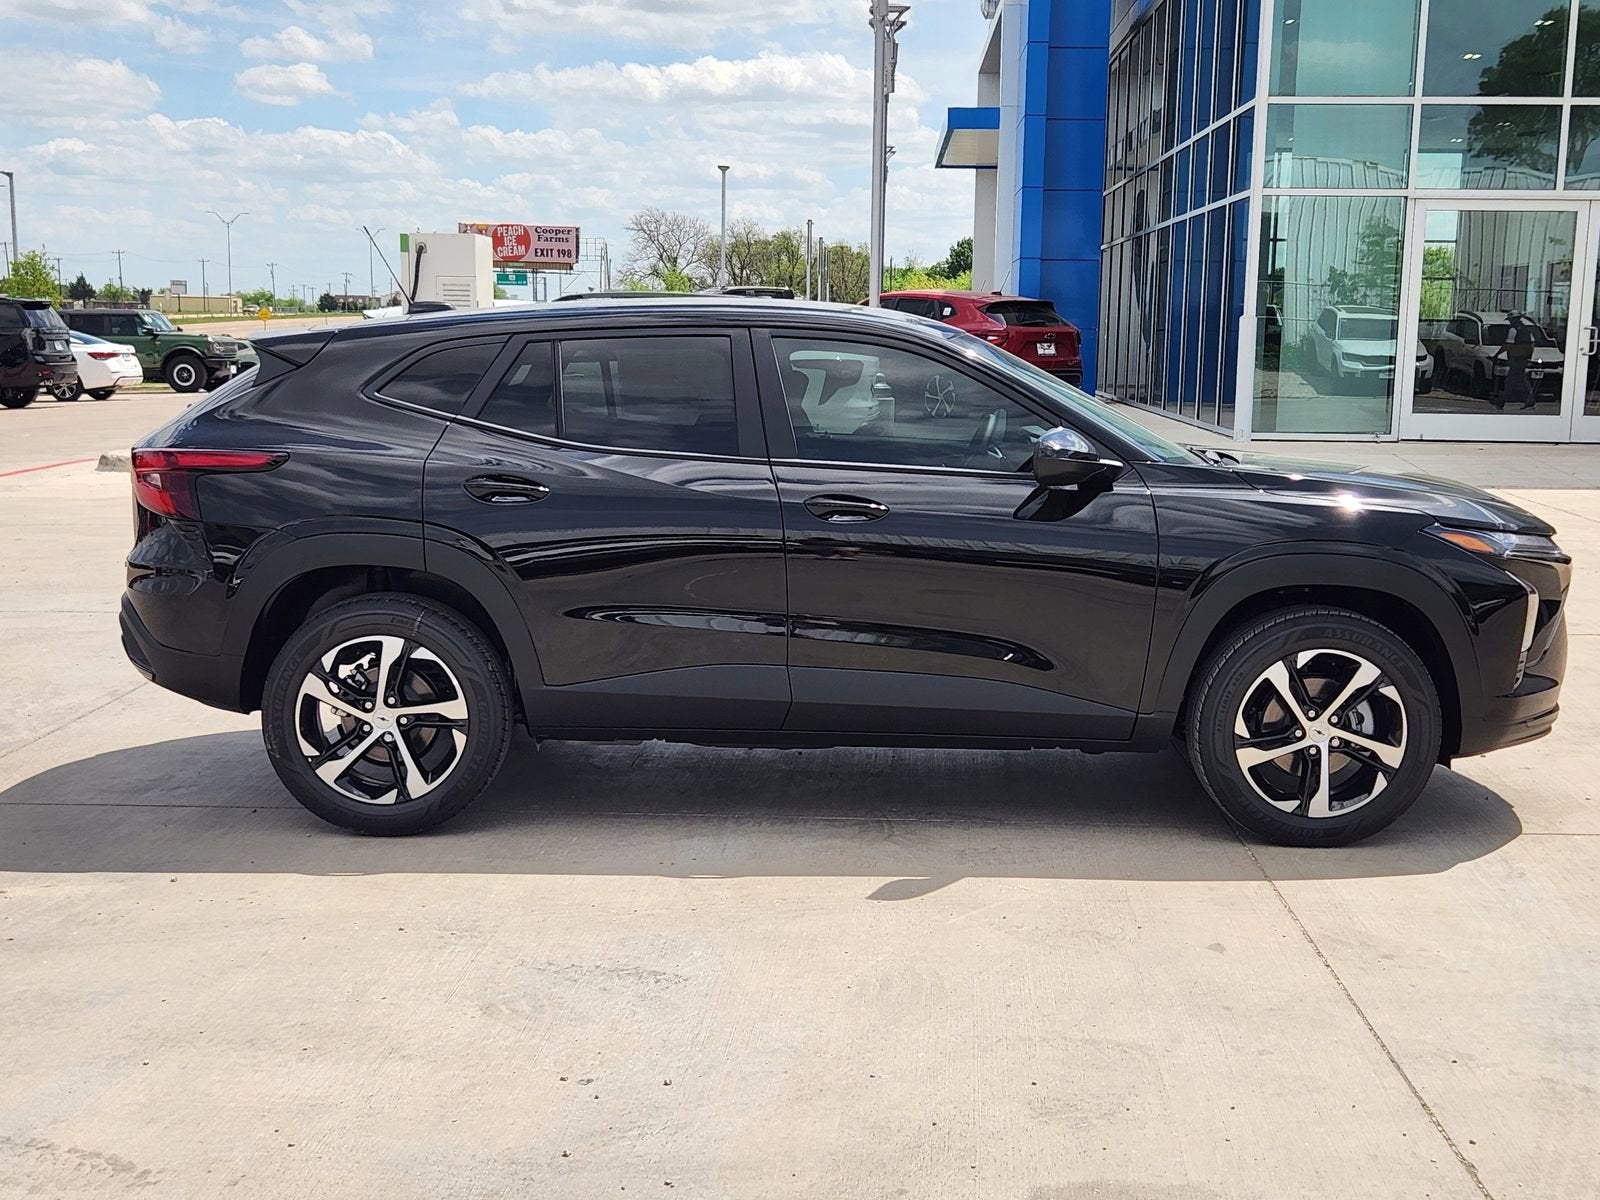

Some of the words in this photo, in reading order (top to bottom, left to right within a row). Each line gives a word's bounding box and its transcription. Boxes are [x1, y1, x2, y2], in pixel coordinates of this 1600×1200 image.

[497, 226, 524, 237] PEACH
[535, 226, 573, 235] Cooper
[504, 236, 517, 246] ICE
[537, 234, 570, 243] Farms
[497, 245, 526, 257] CREAM
[534, 247, 554, 258] EXIT
[556, 248, 573, 259] 198
[1323, 627, 1407, 669] ASSURANCE
